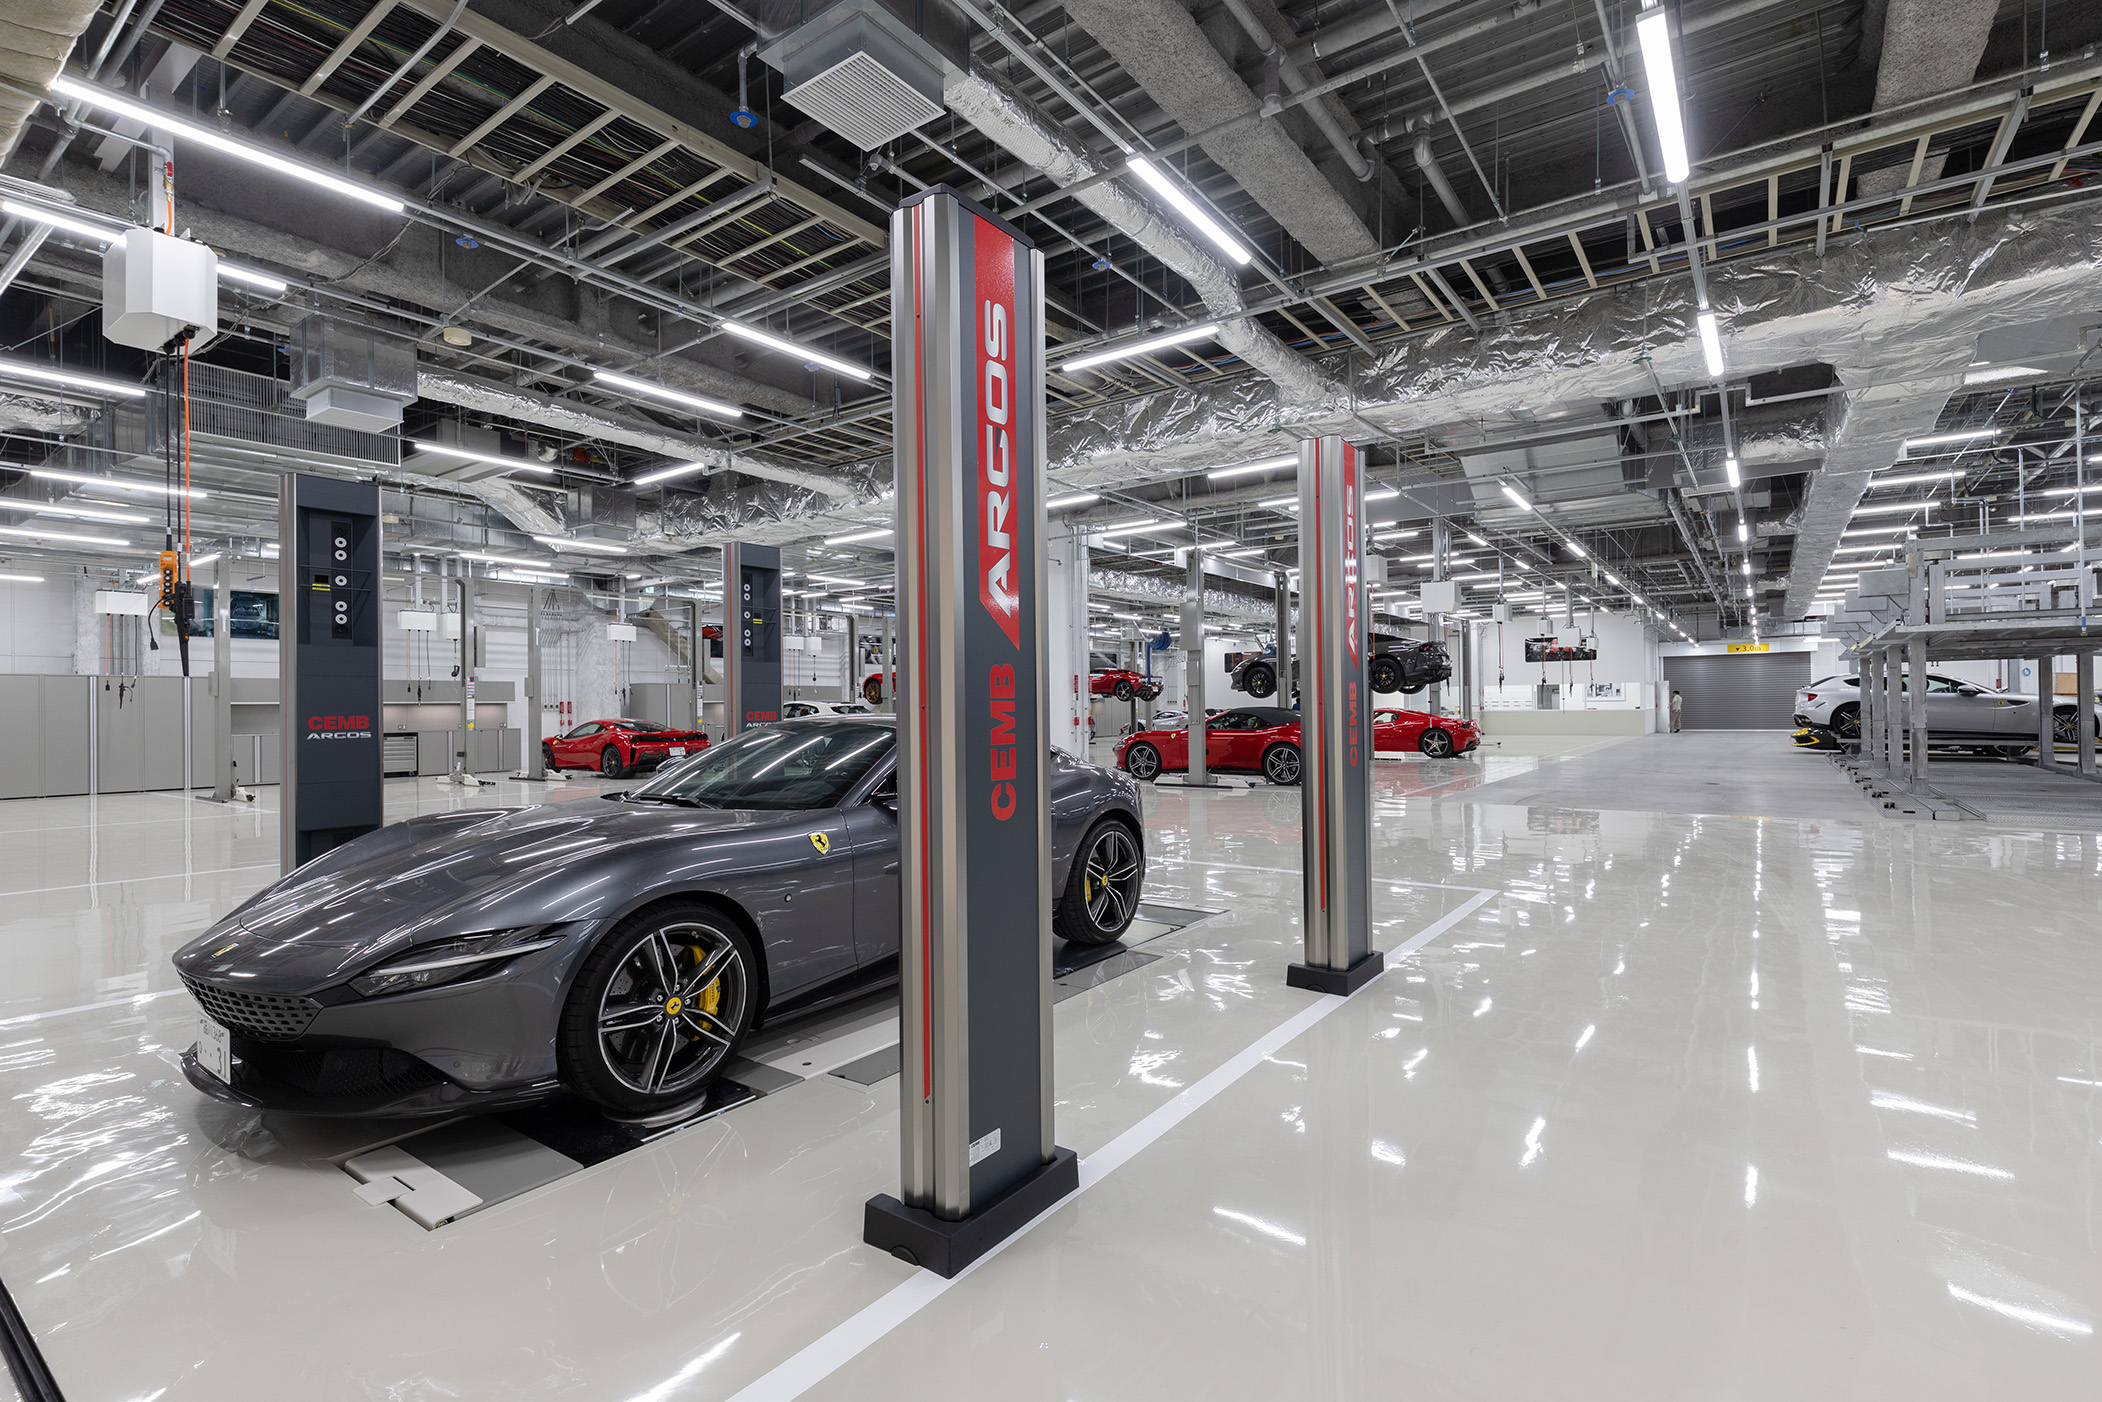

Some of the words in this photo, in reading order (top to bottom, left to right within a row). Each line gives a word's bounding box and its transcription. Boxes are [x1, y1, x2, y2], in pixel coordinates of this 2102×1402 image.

[985, 300, 1011, 618] ARGOS
[307, 732, 371, 740] ARGOS
[308, 716, 369, 730] CEMB
[746, 711, 777, 721] CEMB
[1348, 681, 1358, 767] CEMB
[990, 664, 1016, 821] CEMB
